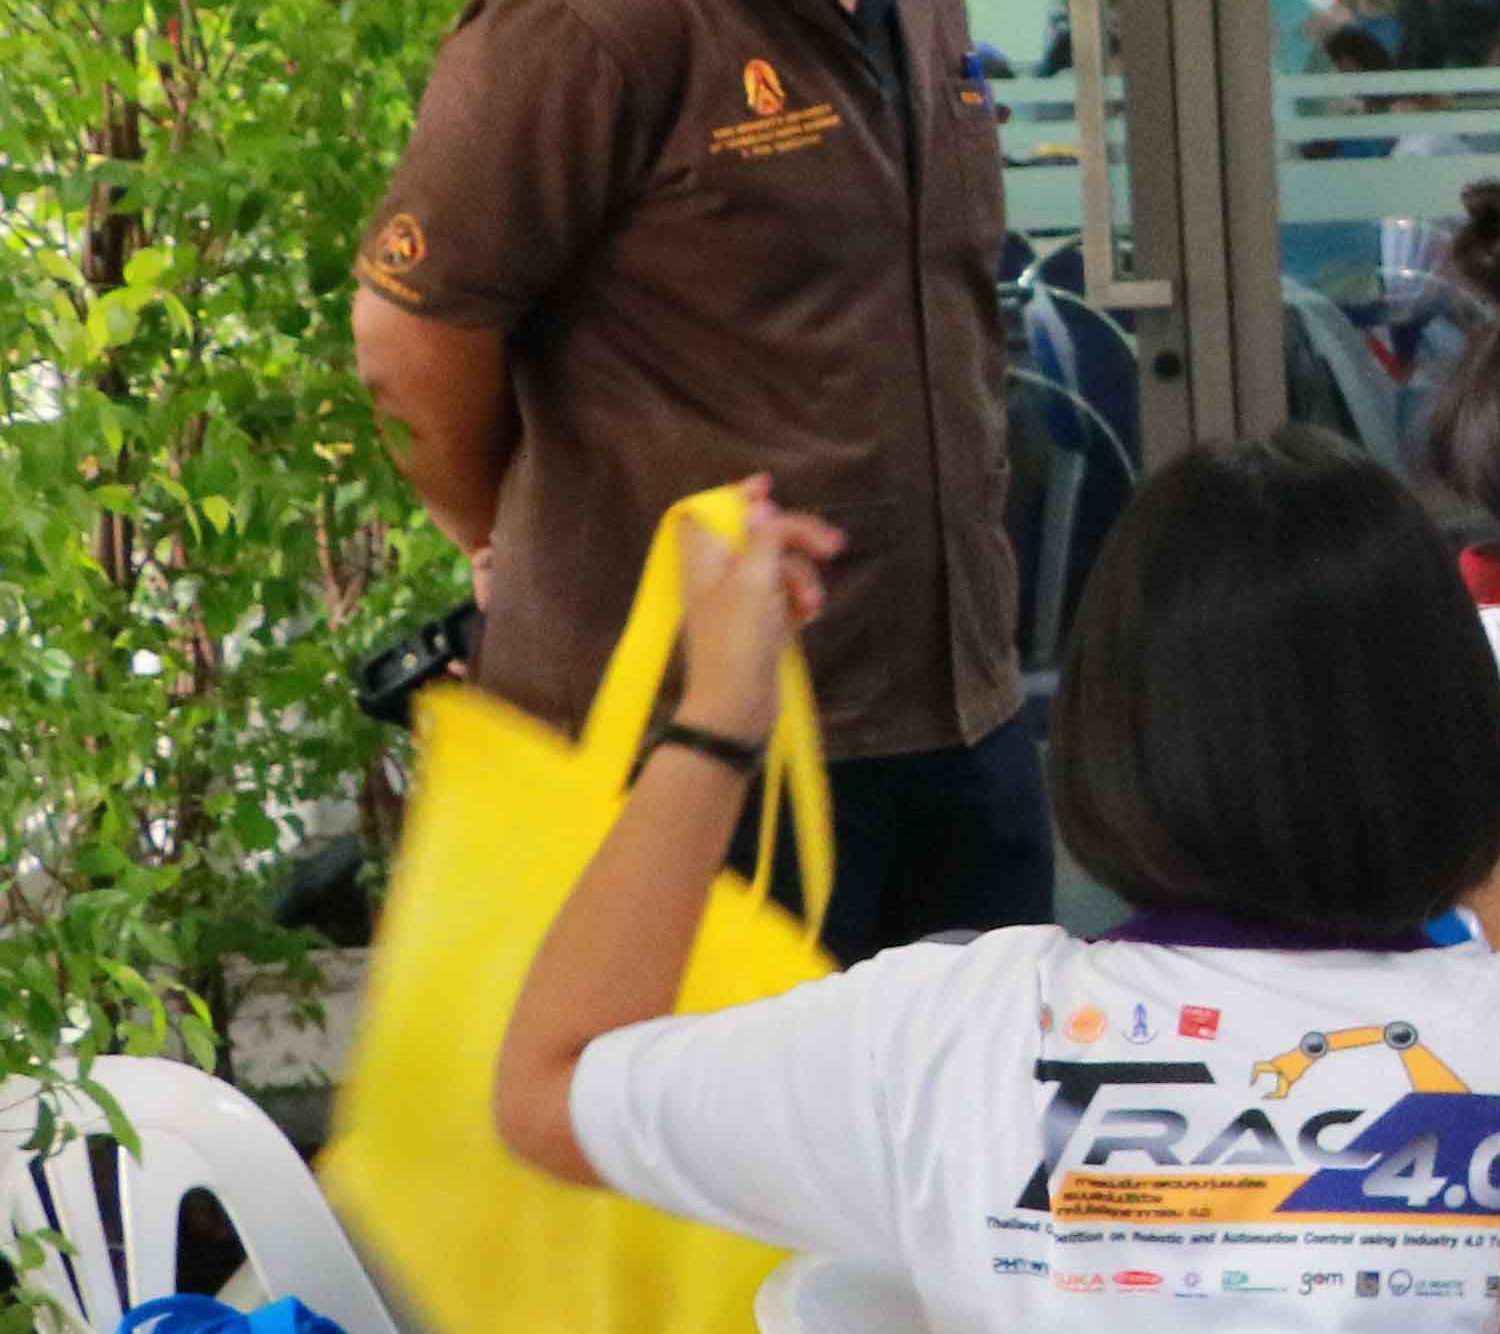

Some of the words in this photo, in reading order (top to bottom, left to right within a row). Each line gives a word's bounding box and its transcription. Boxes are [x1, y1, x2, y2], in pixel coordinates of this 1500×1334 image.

[1014, 1059, 1384, 1210] TRAC
[1221, 1230, 1298, 1245] Automation
[1303, 1231, 1354, 1245] Control
[1360, 1233, 1397, 1249] using
